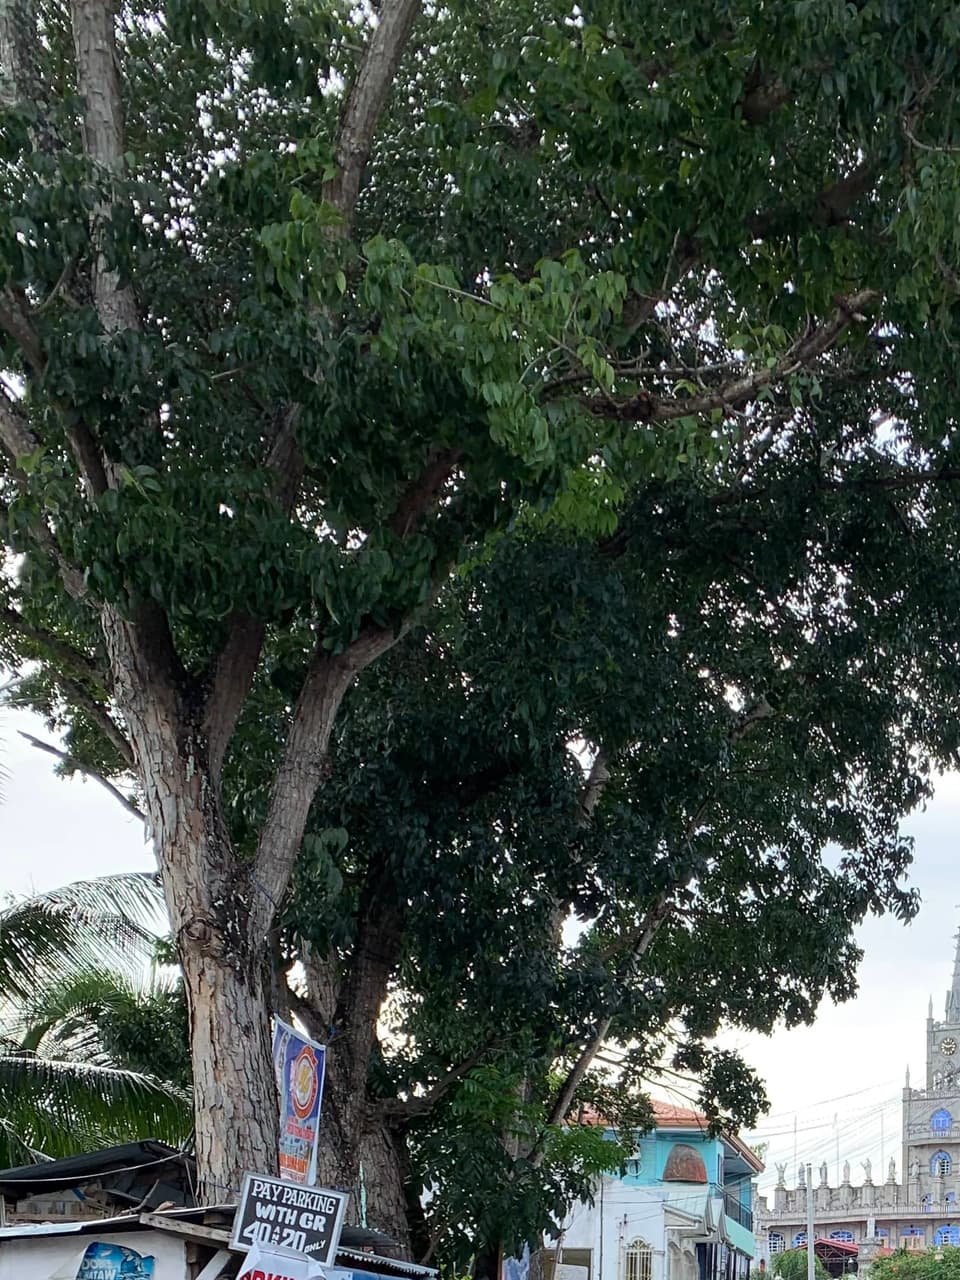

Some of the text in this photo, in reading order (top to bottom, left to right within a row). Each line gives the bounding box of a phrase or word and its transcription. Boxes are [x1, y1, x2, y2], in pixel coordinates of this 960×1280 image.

[250, 1180, 336, 1215] PAY PARKING
[255, 1201, 298, 1226] WITH
[243, 1220, 272, 1243] 40
[280, 1227, 307, 1252] 20
[303, 1239, 326, 1254] ONLY
